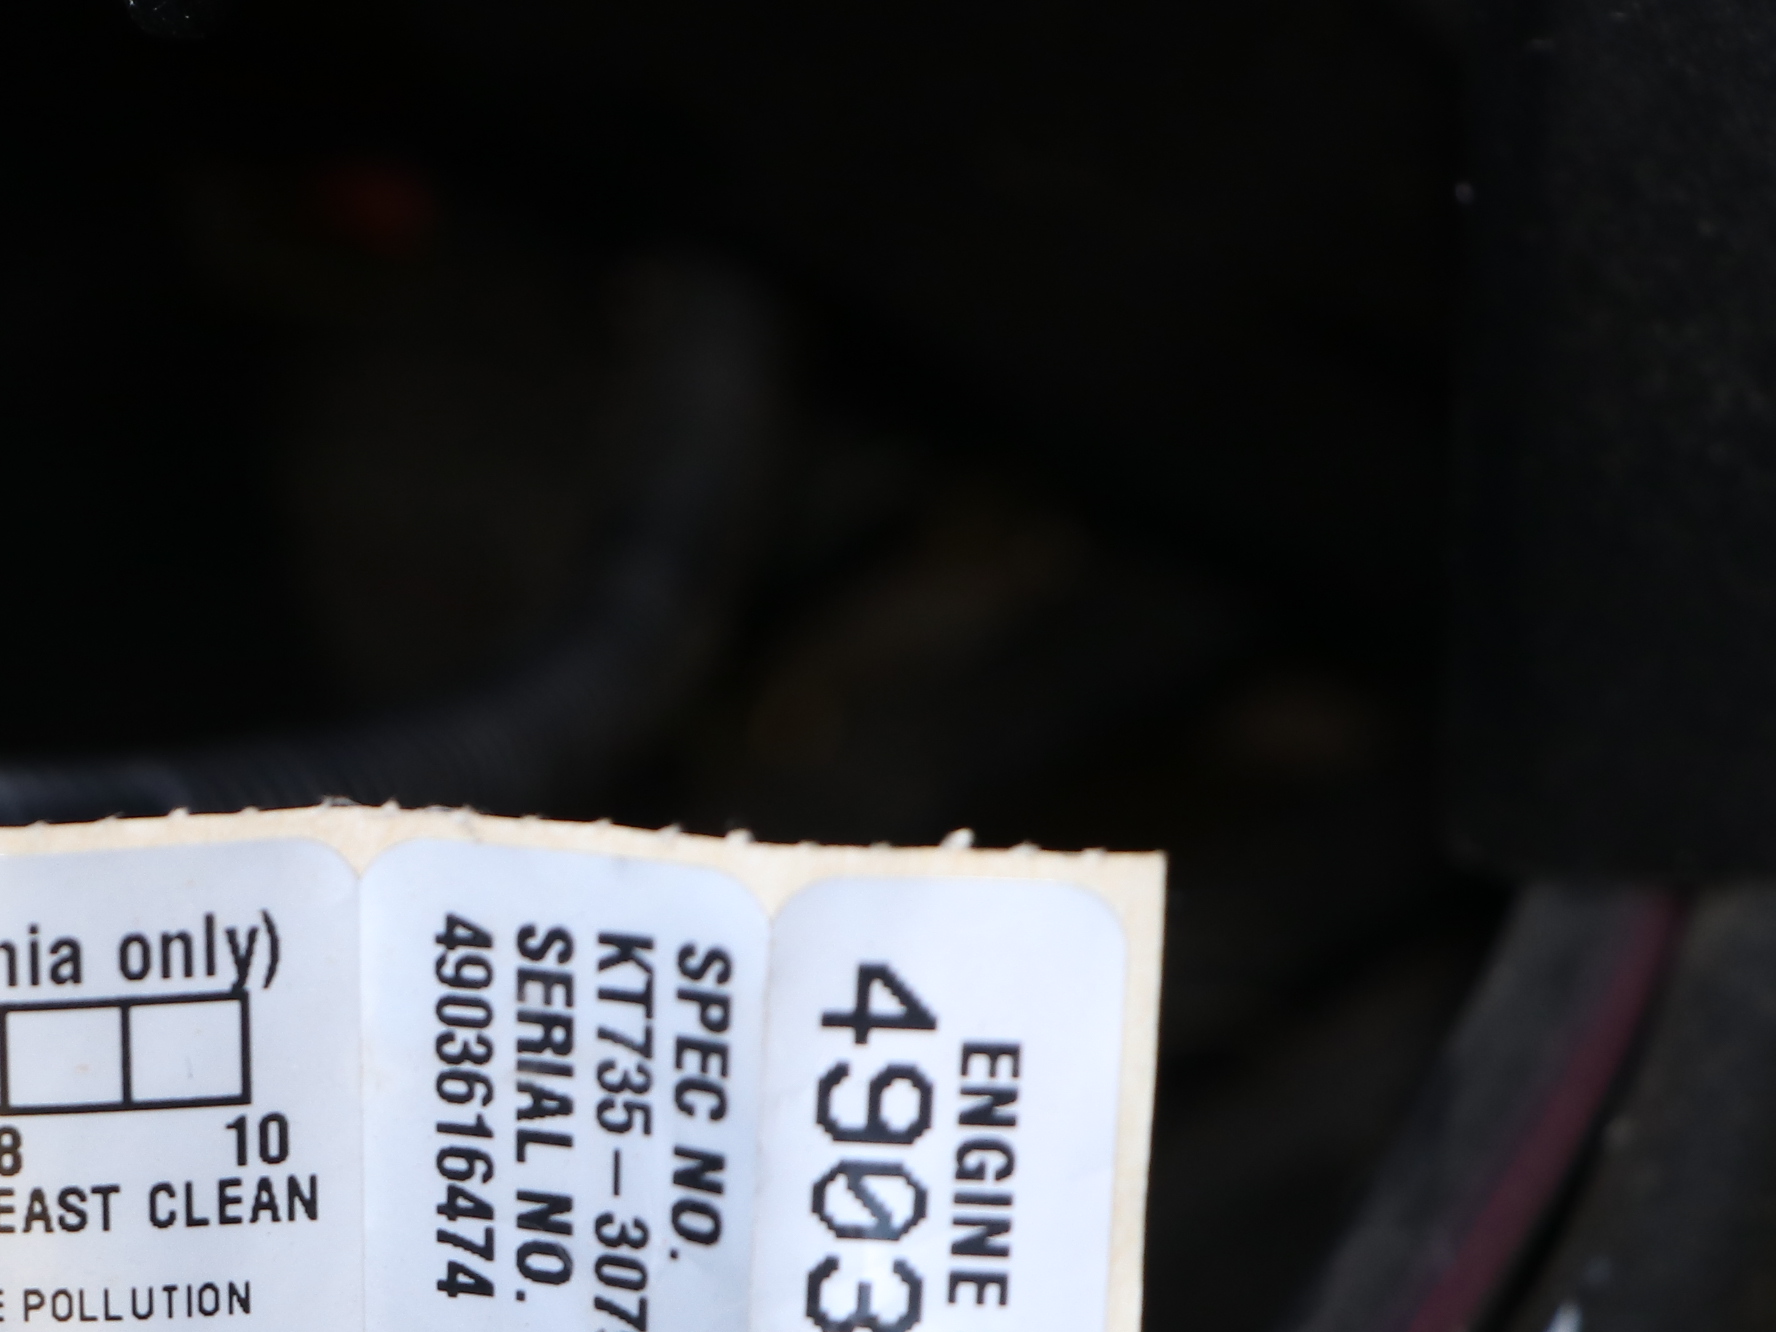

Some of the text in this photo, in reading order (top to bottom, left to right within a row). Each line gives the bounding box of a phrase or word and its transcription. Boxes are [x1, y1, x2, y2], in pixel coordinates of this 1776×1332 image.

[119, 909, 280, 995] only)
[225, 1112, 289, 1167] 10
[434, 912, 495, 1299] 4903616474
[515, 923, 575, 1303] SERIAL NO.
[669, 942, 734, 1262] SPEC NO.
[946, 1041, 1022, 1308] ENGINE
[148, 1174, 318, 1229] CLEAN
[24, 1281, 252, 1322] POLLUTION
